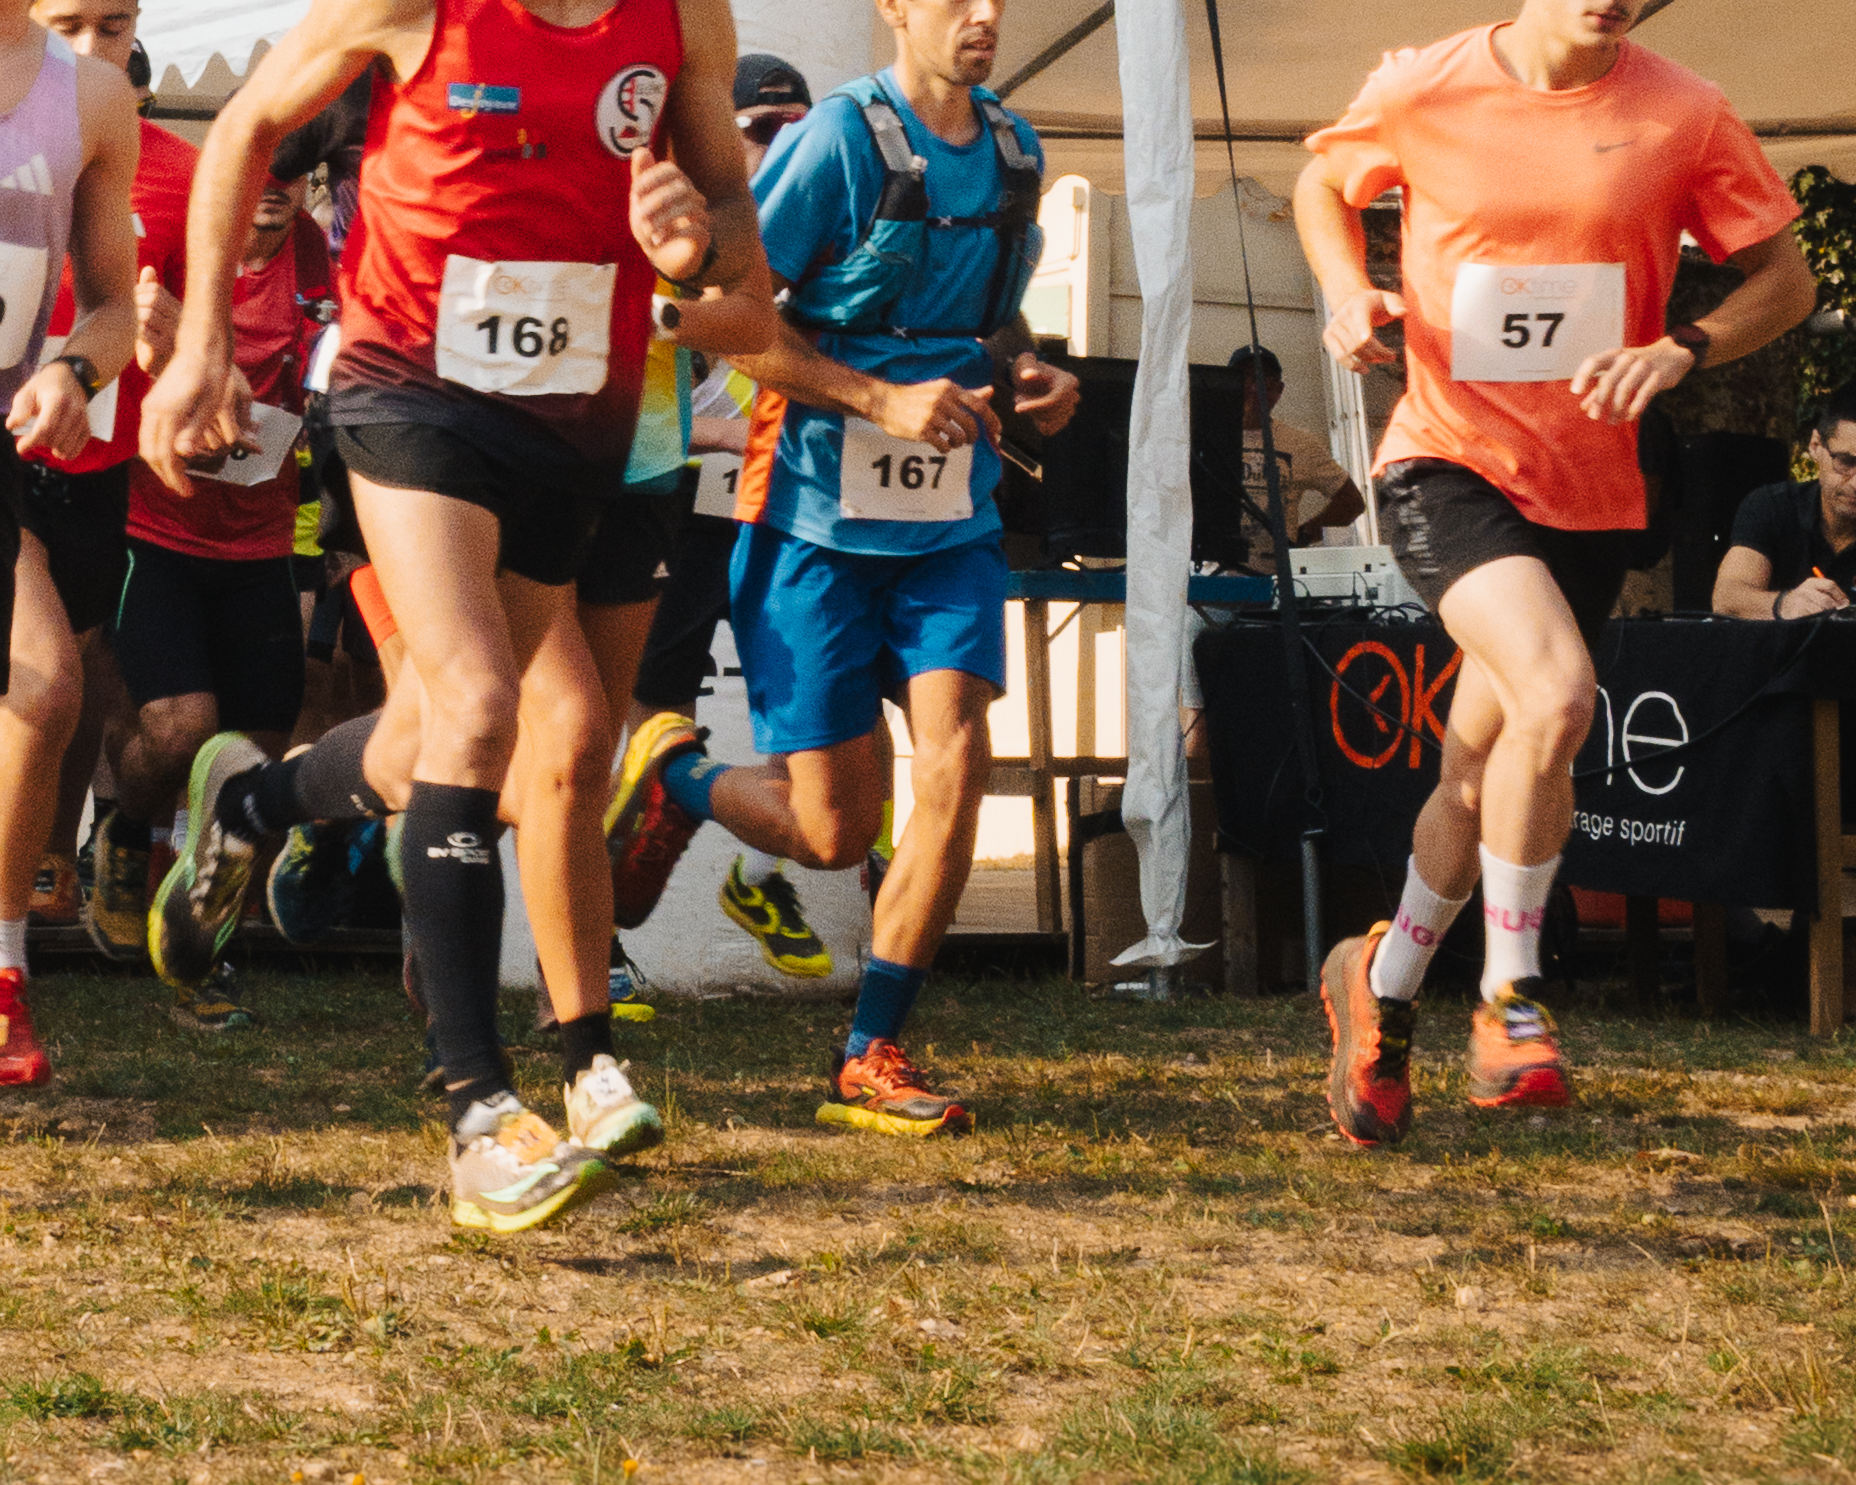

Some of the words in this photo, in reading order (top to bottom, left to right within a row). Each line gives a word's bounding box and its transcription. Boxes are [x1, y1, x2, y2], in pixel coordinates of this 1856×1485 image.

[476, 315, 569, 358] 168
[1501, 312, 1565, 349] 57
[871, 453, 948, 491] 167
[1620, 820, 1686, 846] sportif
